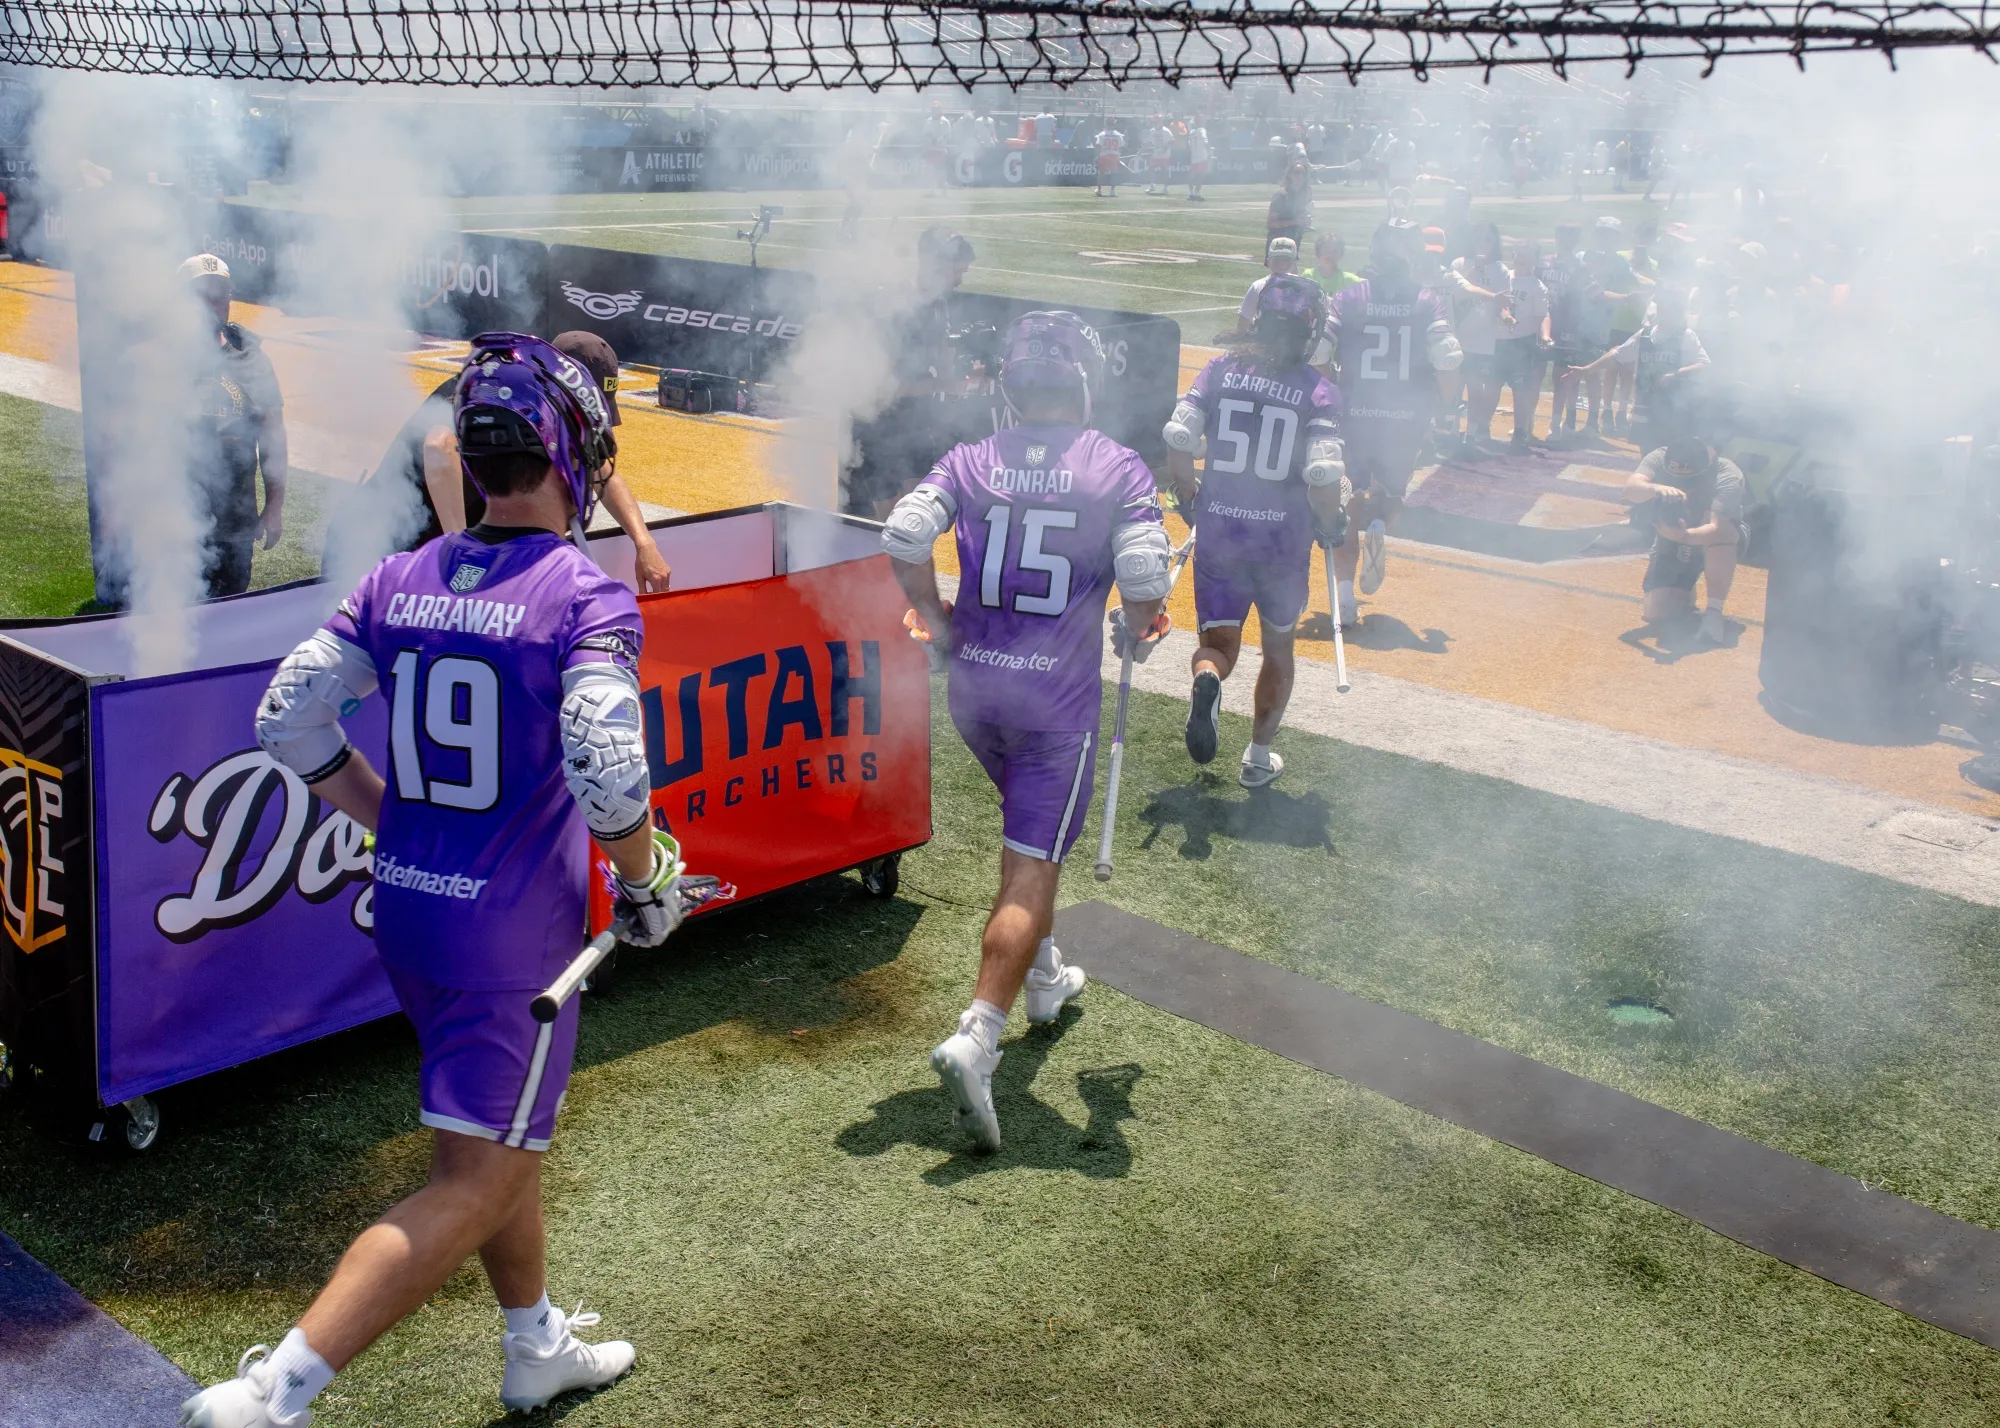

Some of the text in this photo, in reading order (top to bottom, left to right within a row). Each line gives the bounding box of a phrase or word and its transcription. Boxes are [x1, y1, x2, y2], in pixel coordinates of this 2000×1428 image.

[7, 161, 38, 173] UTA
[645, 153, 704, 170] ATHLETIC
[655, 173, 685, 183] BREWING
[955, 152, 976, 183] G
[1003, 151, 1023, 183] G
[1044, 159, 1110, 176] ticketmas
[202, 233, 235, 258] Cash
[238, 238, 267, 266] App
[402, 248, 499, 304] hirlpool
[643, 306, 803, 339] cascade
[1366, 303, 1411, 317] BYRNES
[1360, 324, 1411, 381] 21
[1222, 372, 1303, 406] SCARPELLO
[1349, 406, 1415, 421] ticketmaster
[1212, 398, 1299, 481] 50
[990, 467, 1073, 494] CONRAD
[980, 504, 1078, 618] 15
[385, 592, 527, 638] CARRAWAY
[388, 647, 503, 814] 19
[640, 640, 882, 791] UTAH
[652, 751, 878, 836] ARCHERS
[35, 776, 65, 918] PLL
[374, 851, 489, 901] icketmaster
